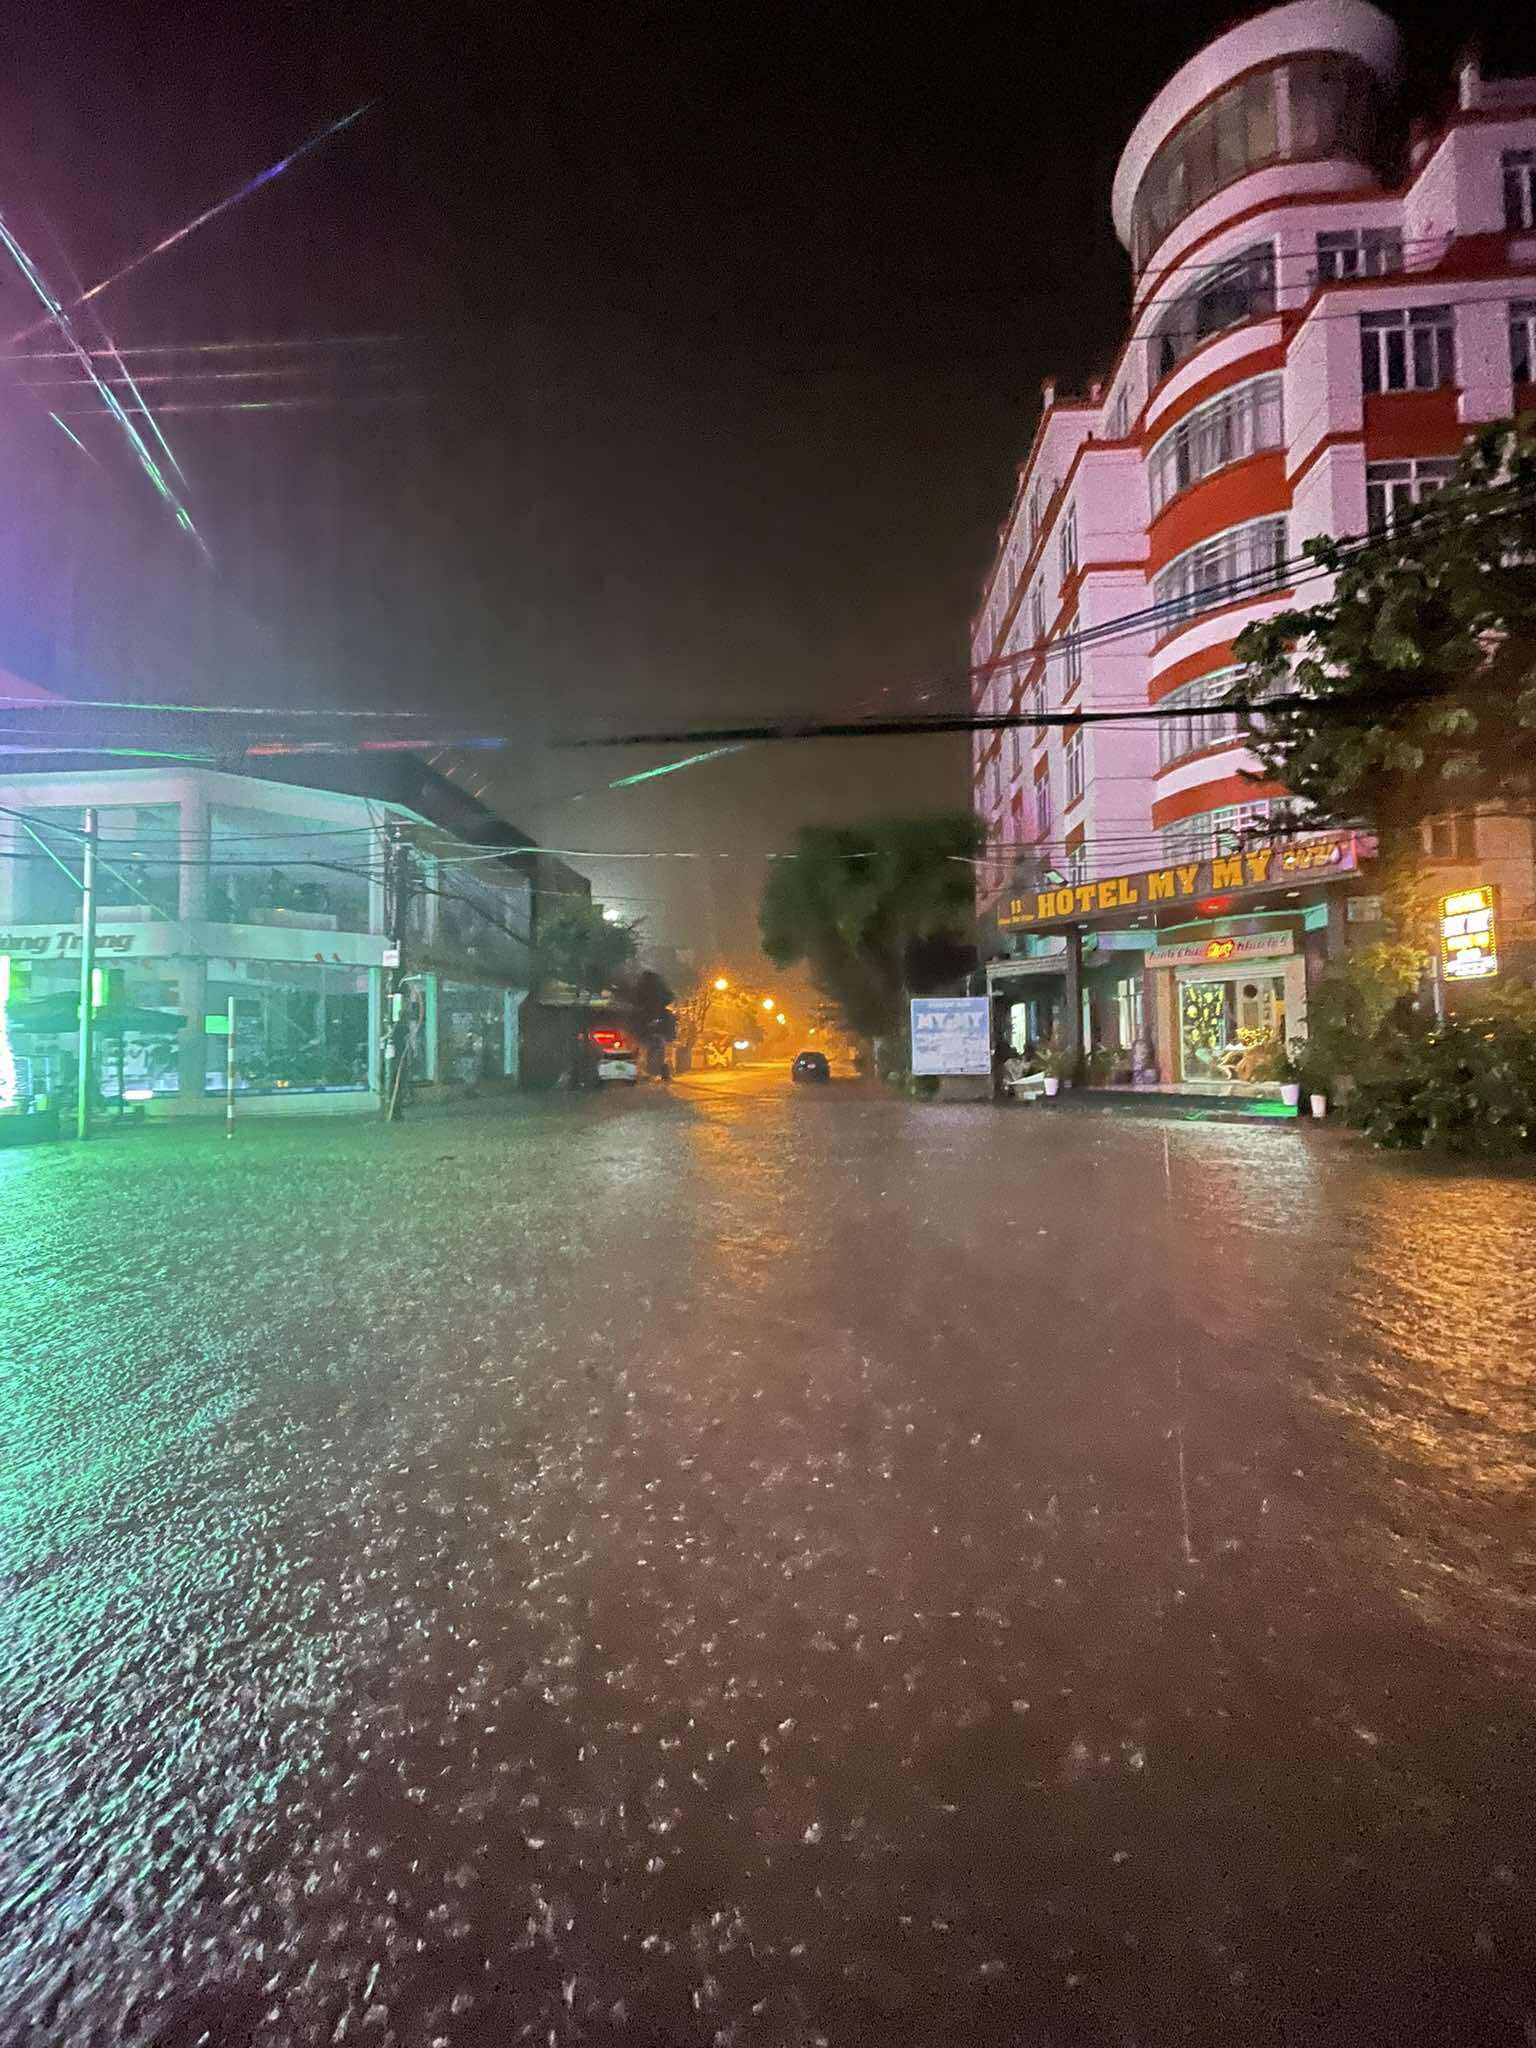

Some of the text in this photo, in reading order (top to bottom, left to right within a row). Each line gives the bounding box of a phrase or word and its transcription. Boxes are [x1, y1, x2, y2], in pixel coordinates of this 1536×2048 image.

[1038, 877, 1138, 919] HOTEL
[1148, 864, 1199, 901] MY
[1211, 848, 1272, 889] MY
[56, 932, 136, 952] Trng
